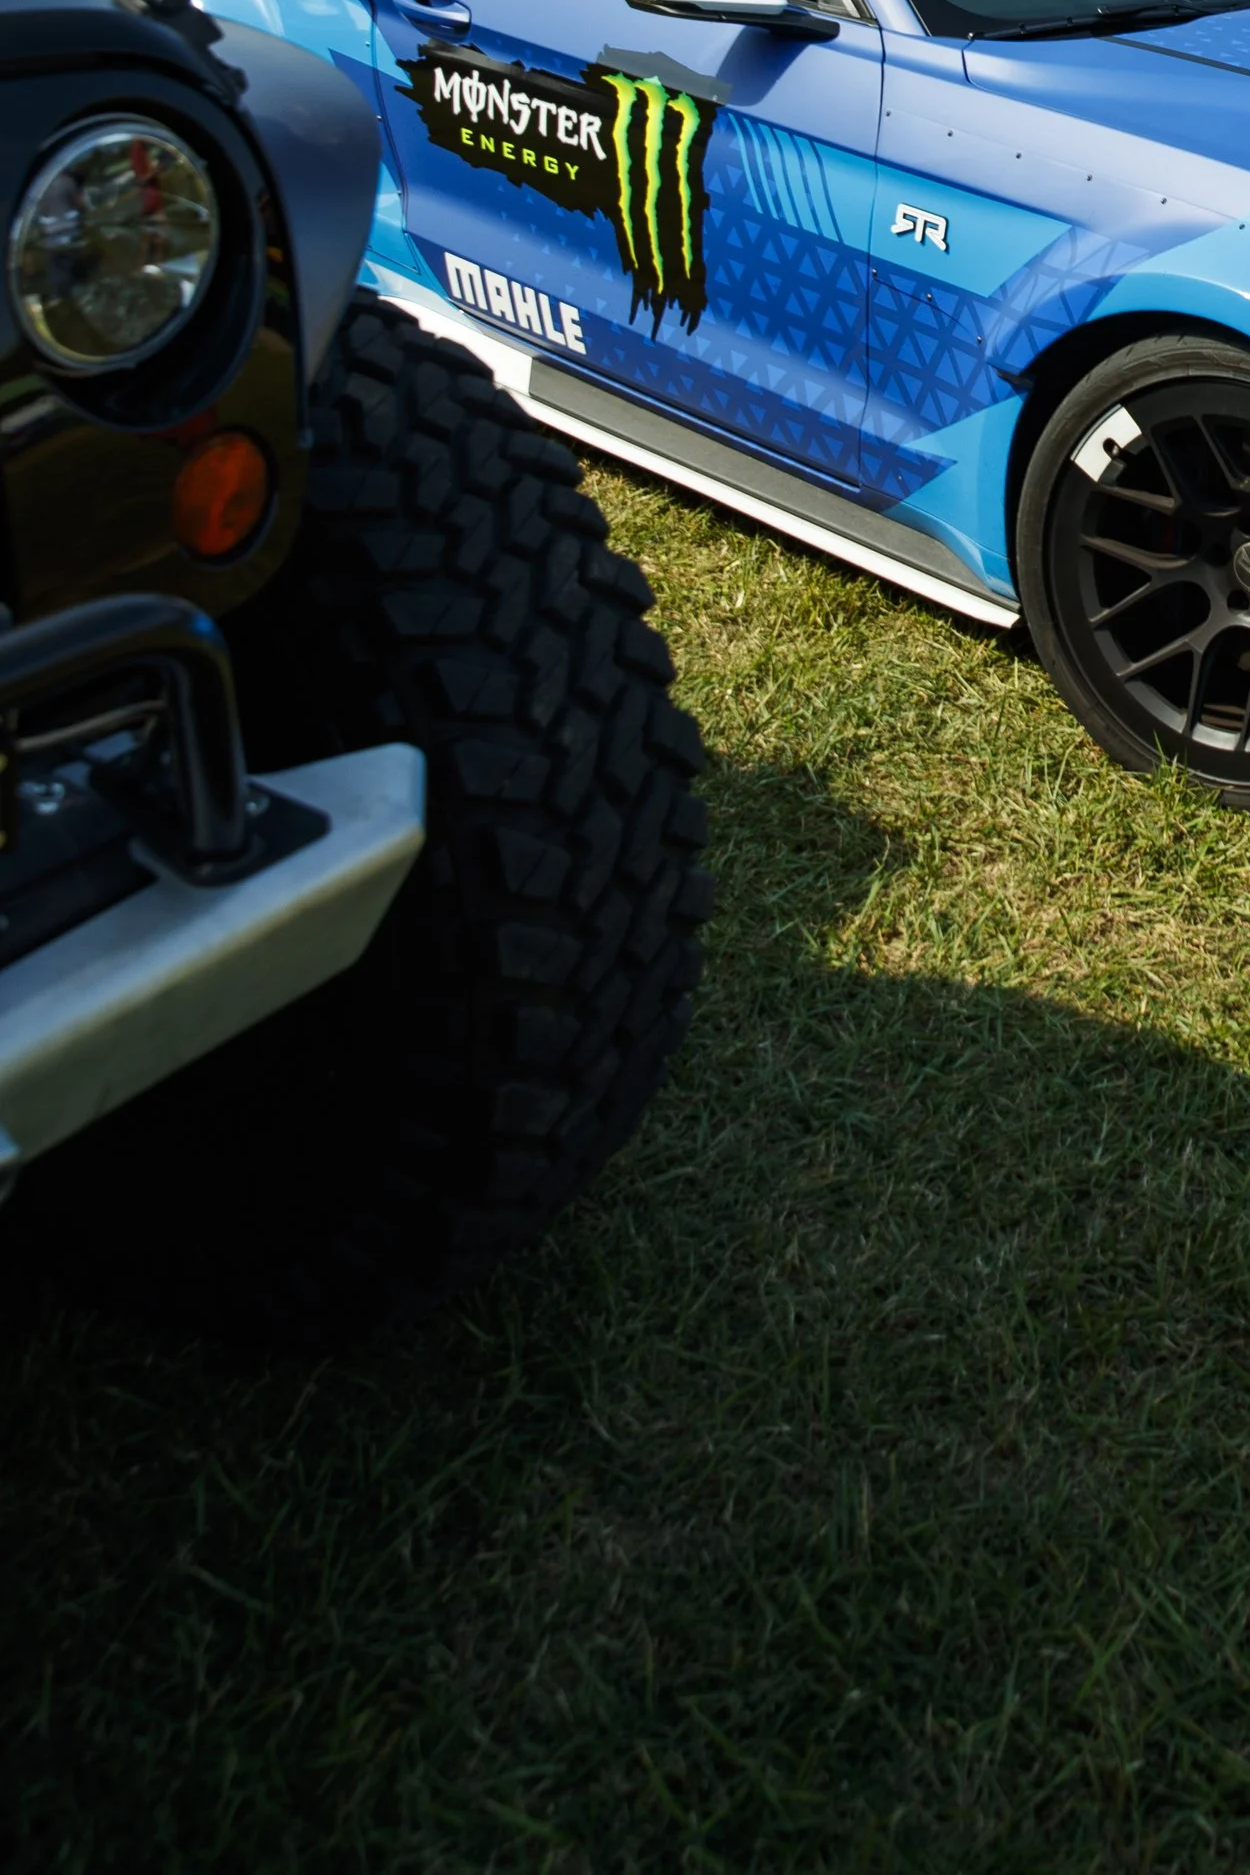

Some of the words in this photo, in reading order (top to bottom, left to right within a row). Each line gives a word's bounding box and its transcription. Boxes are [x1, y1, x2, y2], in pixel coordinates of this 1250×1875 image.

[433, 67, 606, 159] MONSTER
[460, 128, 580, 181] ENERGY
[445, 252, 587, 354] MAHLE
